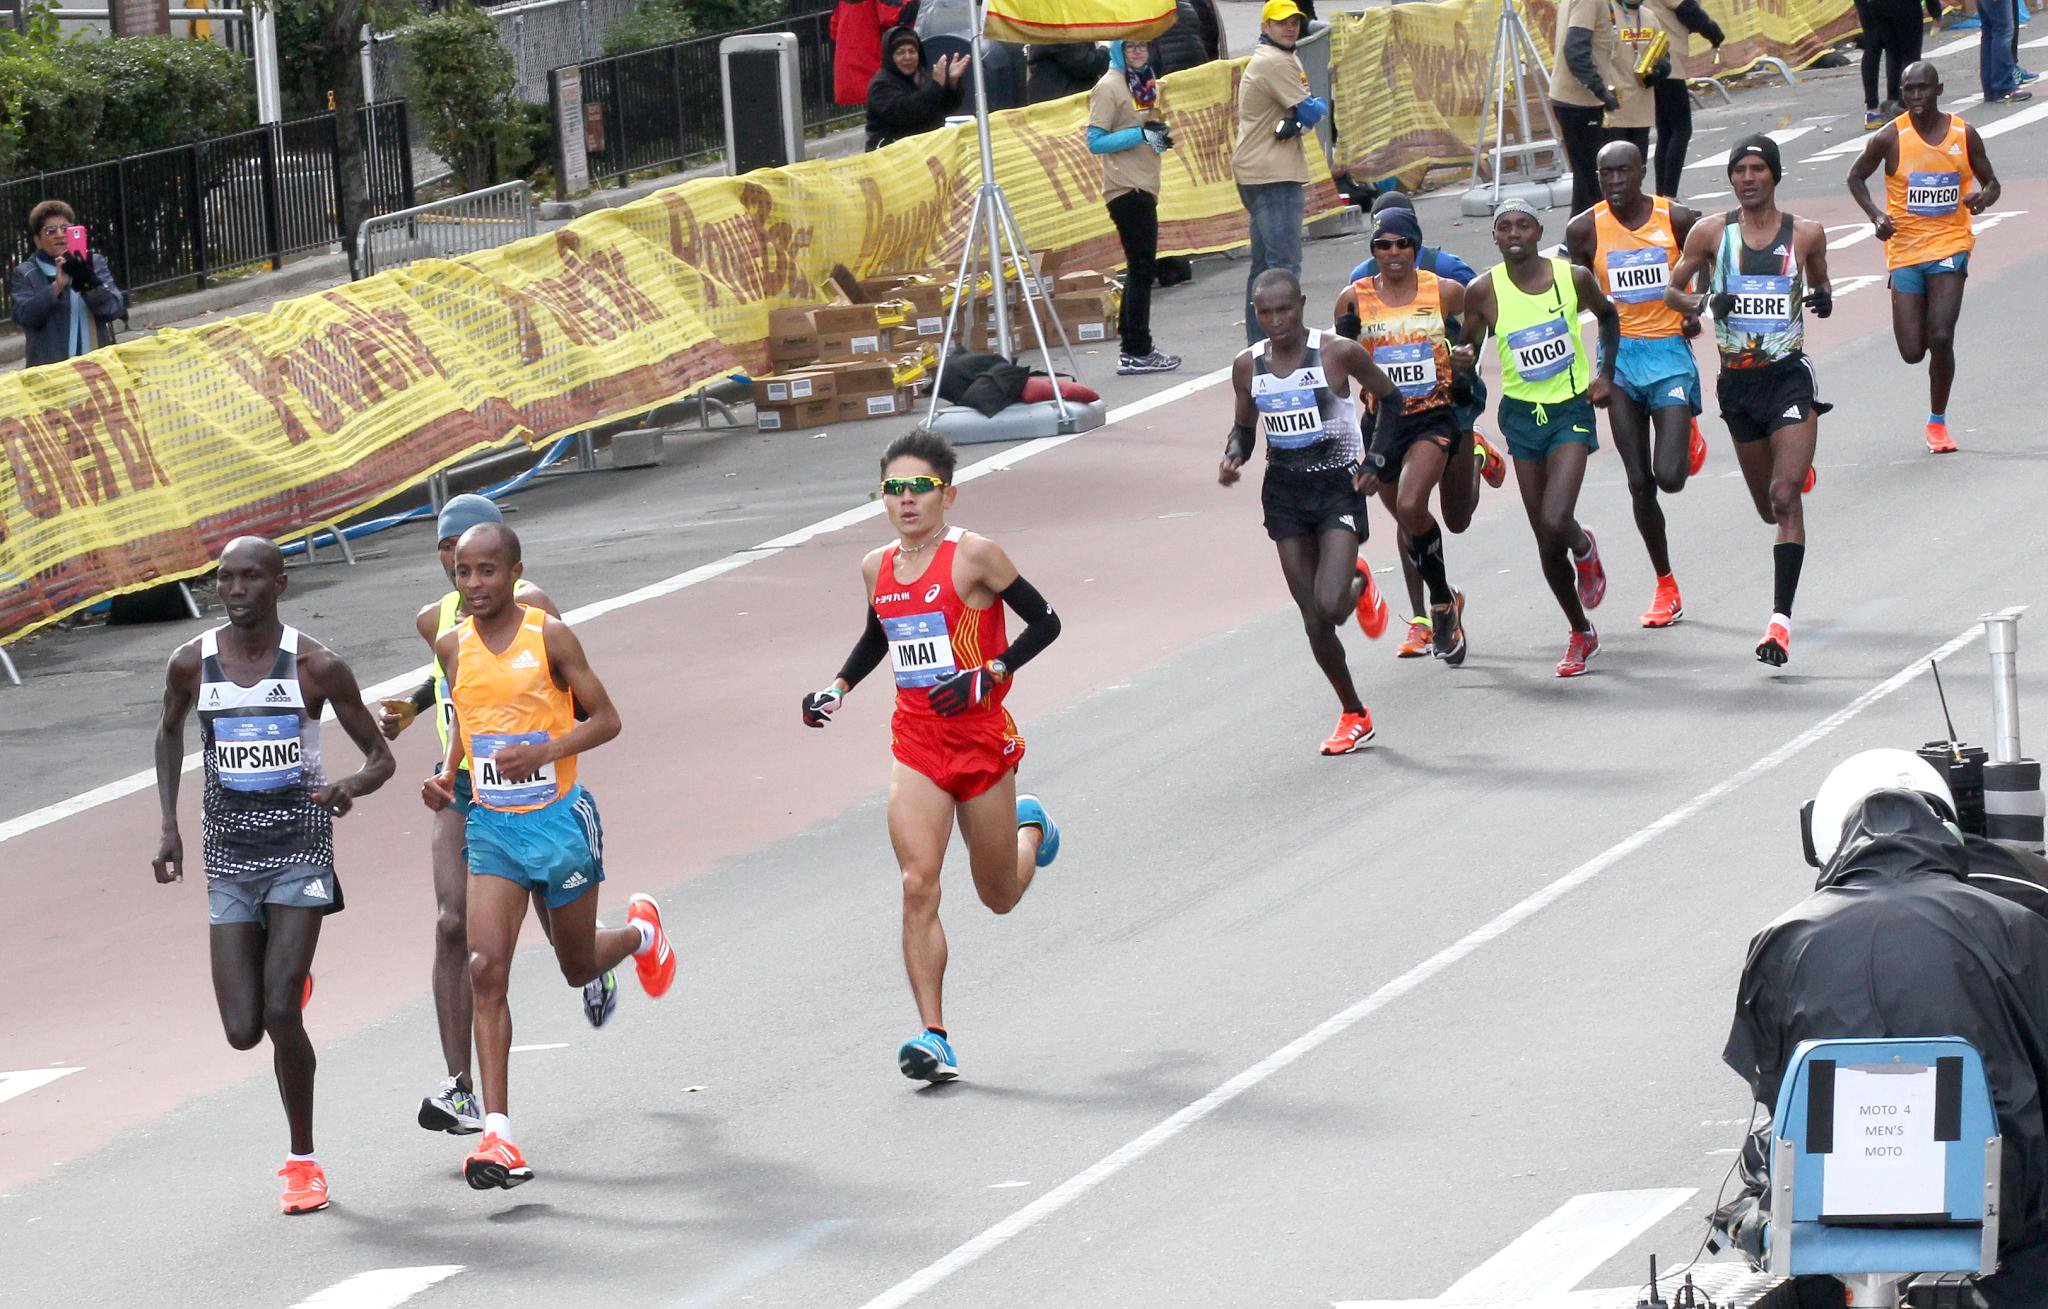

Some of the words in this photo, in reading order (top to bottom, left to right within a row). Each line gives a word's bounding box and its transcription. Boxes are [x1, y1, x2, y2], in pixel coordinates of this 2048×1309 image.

[1909, 188, 1958, 204] KIPYEGO
[1616, 267, 1662, 288] KIRUI
[1732, 297, 1786, 315] GEBRE
[1520, 339, 1566, 367] KOGO
[1388, 365, 1424, 383] MEB
[1264, 412, 1316, 433] MUTAI
[898, 641, 937, 666] IMAI
[217, 741, 300, 769] KIPSANG
[1860, 1105, 1897, 1116] MOTO
[1903, 1105, 1911, 1115] 4
[1865, 1126, 1904, 1136] MEN'S
[1865, 1146, 1903, 1157] MOTO
